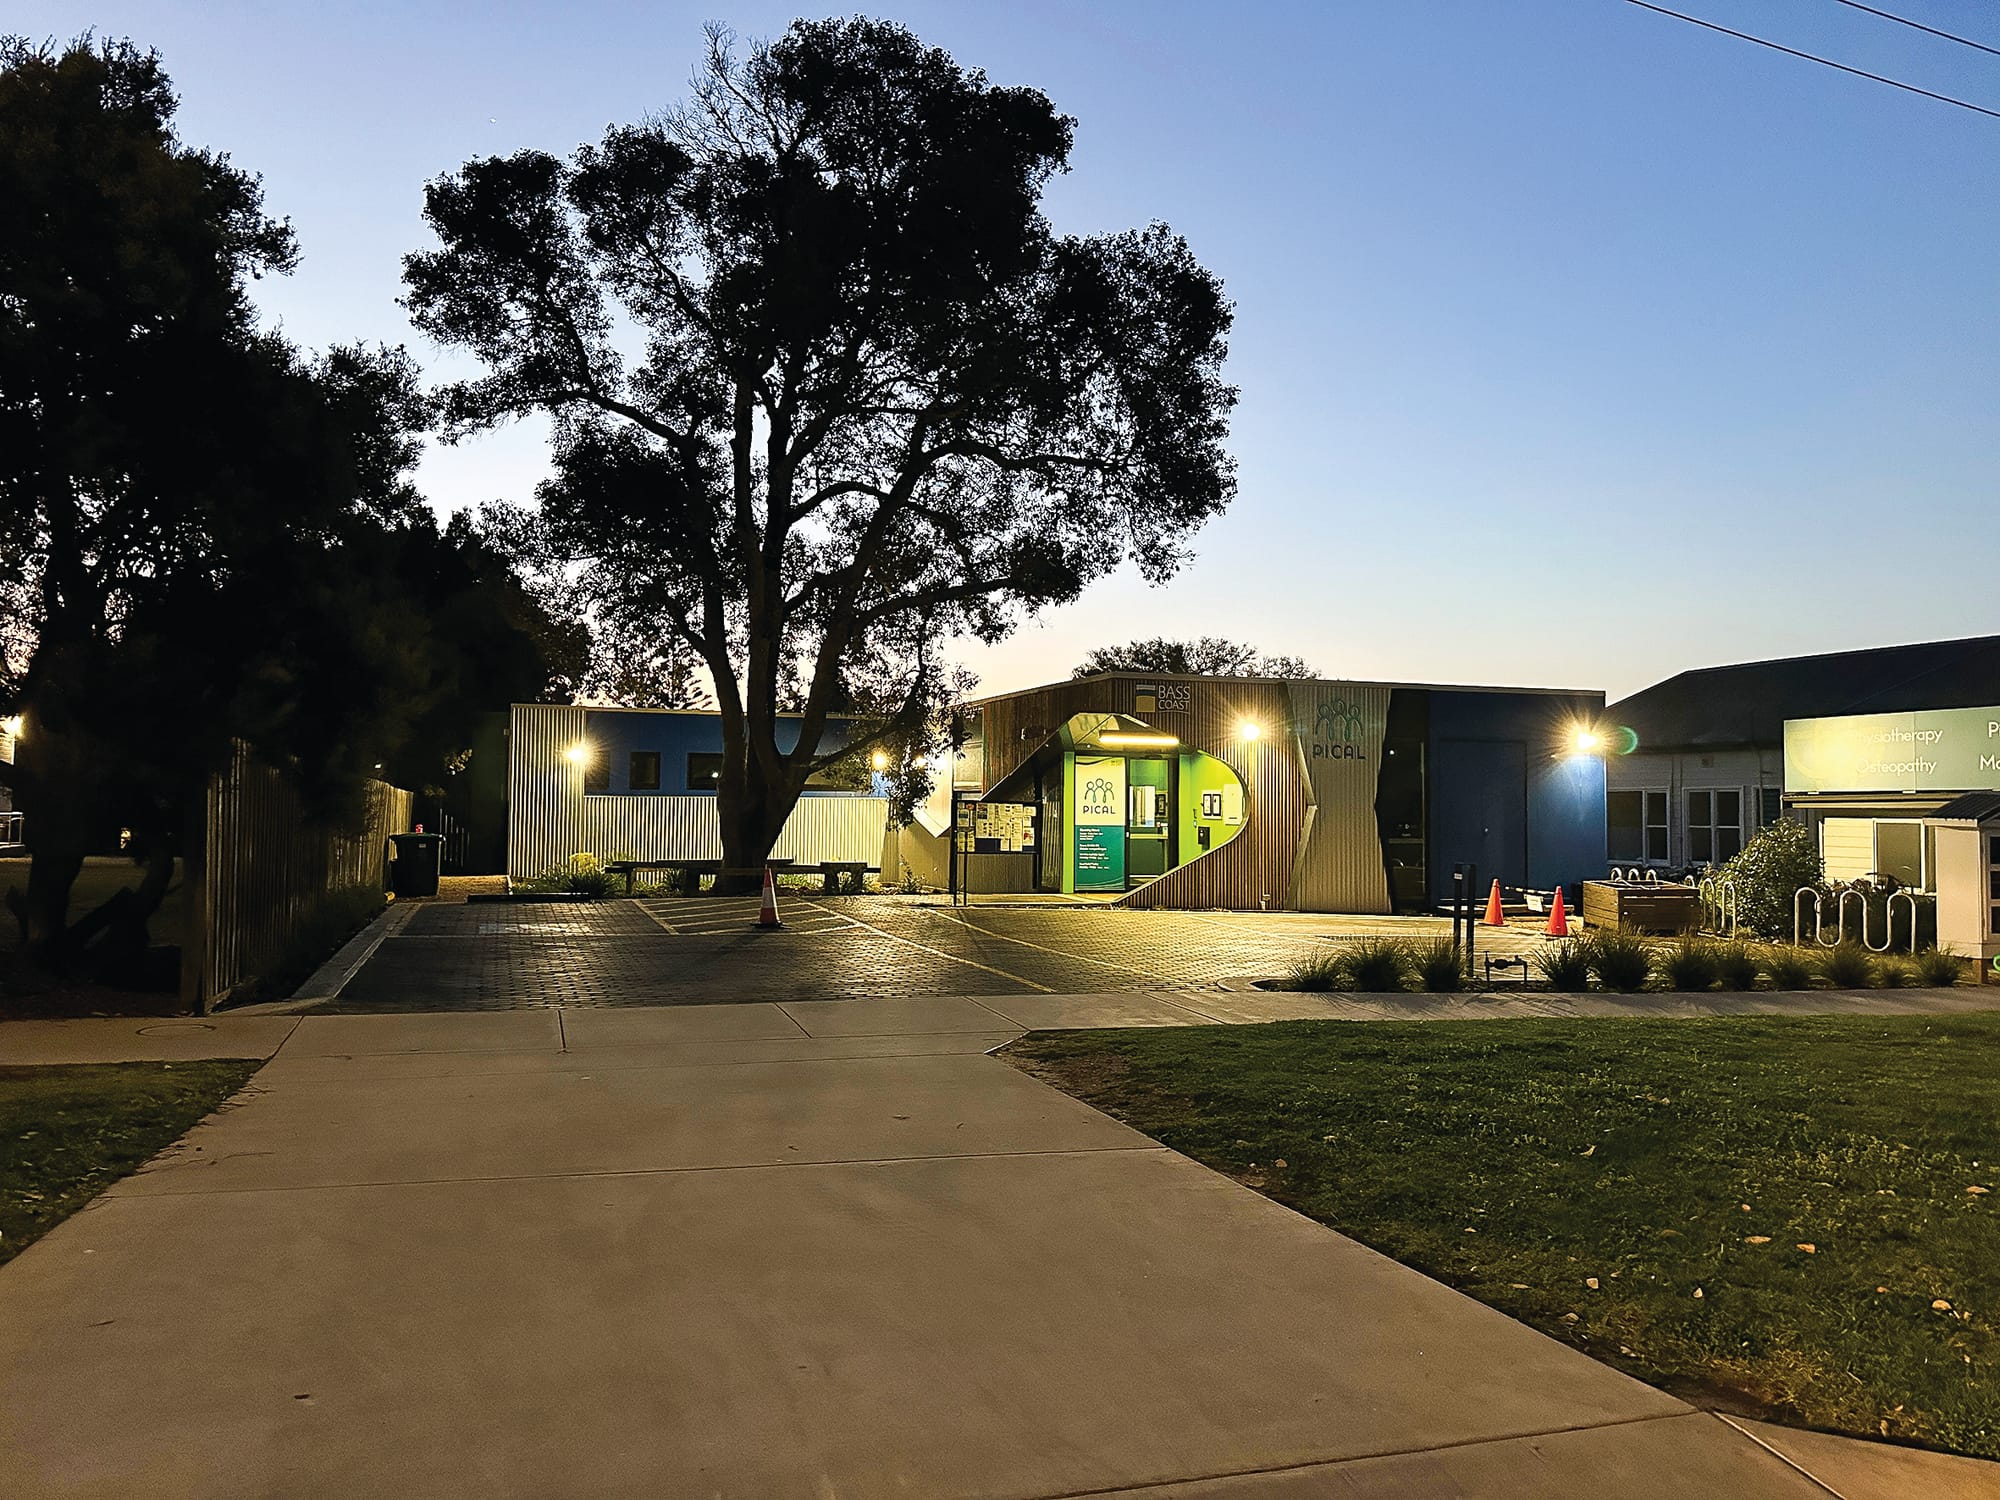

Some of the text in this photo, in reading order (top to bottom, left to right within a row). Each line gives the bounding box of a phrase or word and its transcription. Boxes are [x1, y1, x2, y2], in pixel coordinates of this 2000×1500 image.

[1158, 685, 1191, 699] BASS
[1158, 700, 1190, 710] COAST
[1847, 727, 1943, 746] hysiotherapy
[1313, 744, 1366, 760] PICAL
[1856, 756, 1937, 777] Osteopathy
[1083, 805, 1116, 814] PICAL
